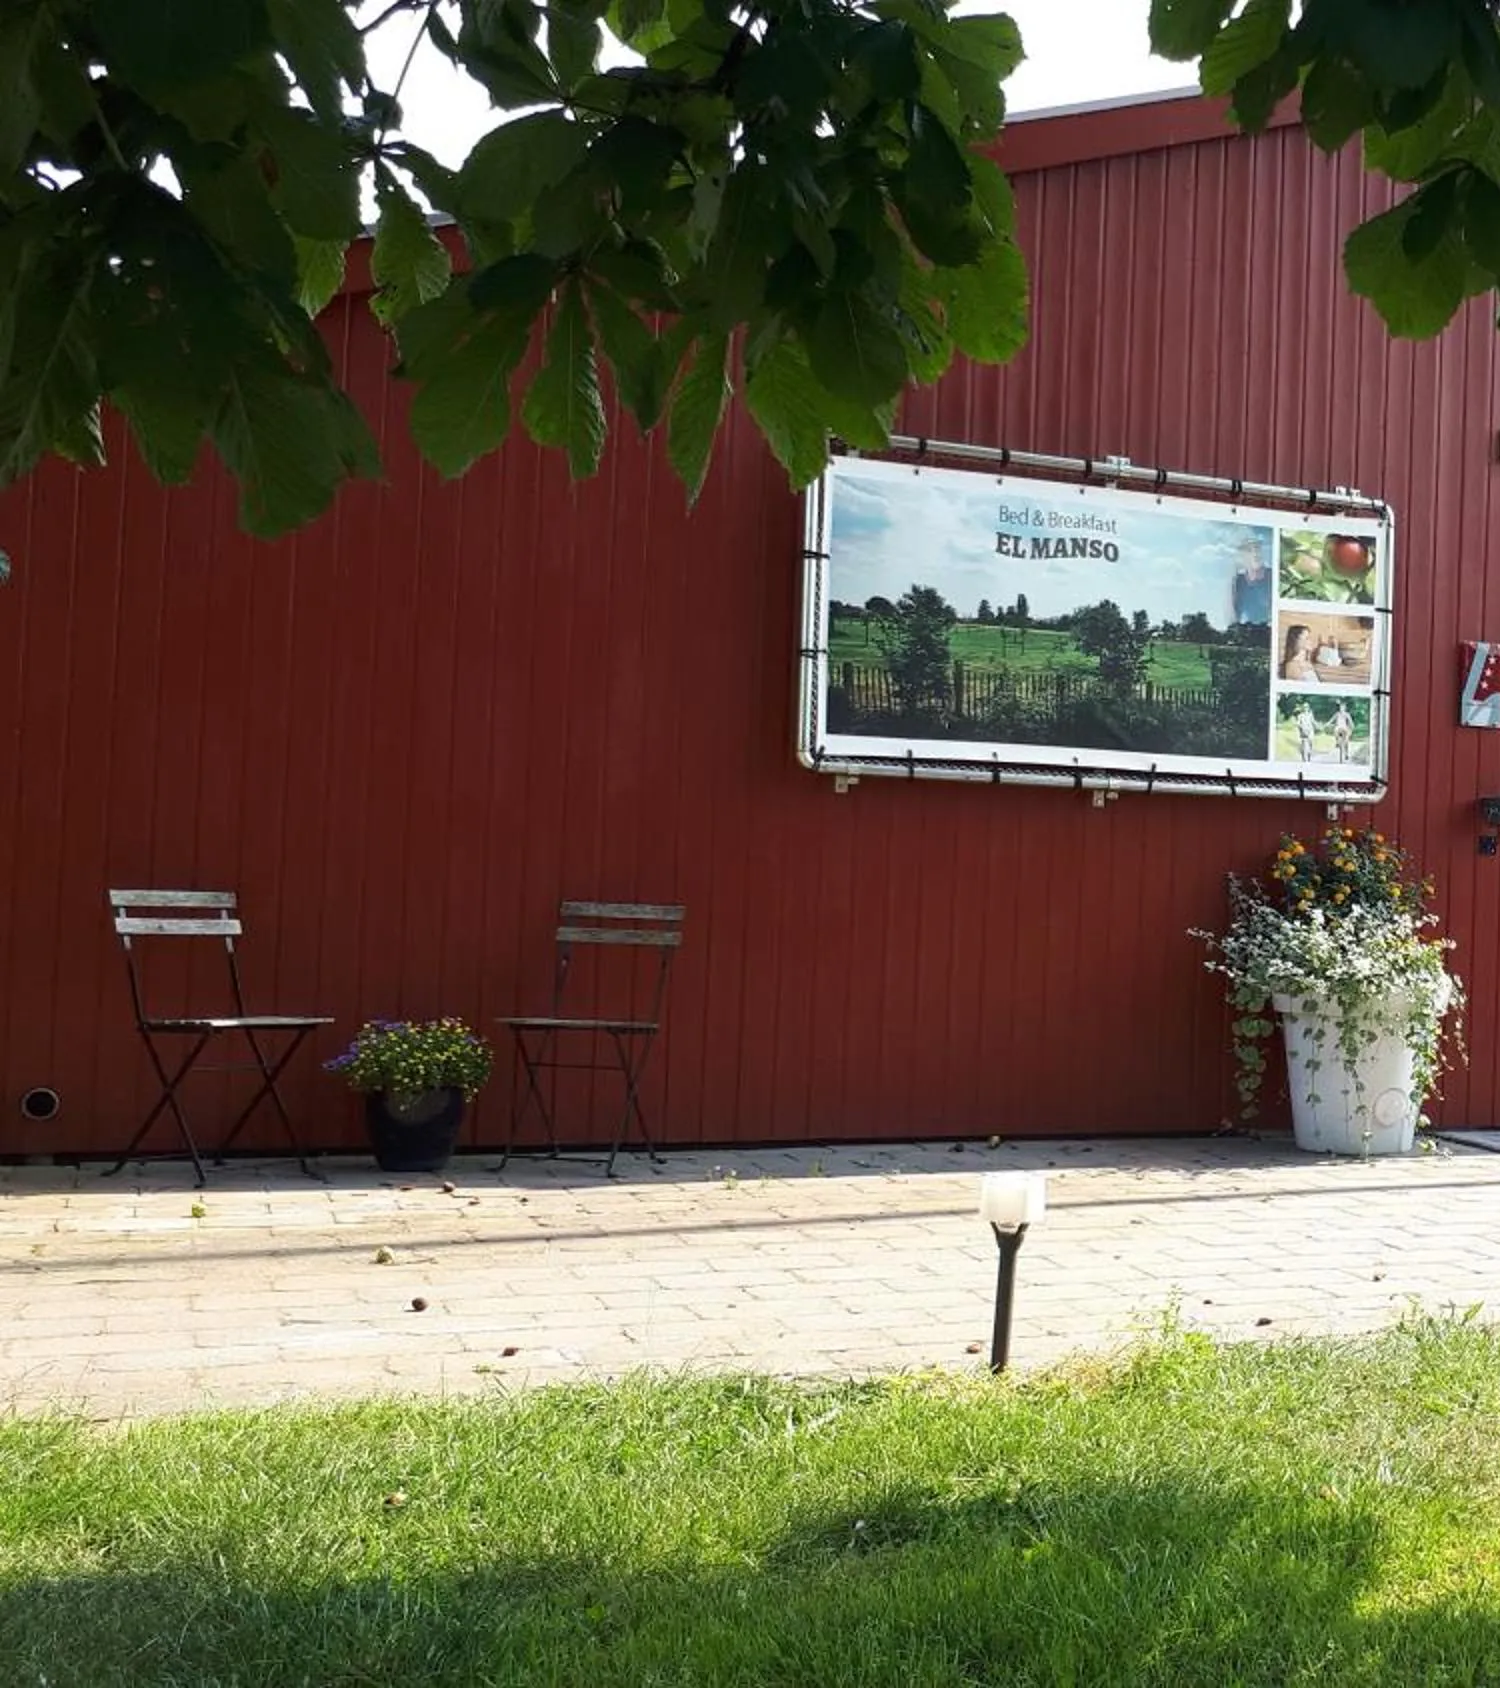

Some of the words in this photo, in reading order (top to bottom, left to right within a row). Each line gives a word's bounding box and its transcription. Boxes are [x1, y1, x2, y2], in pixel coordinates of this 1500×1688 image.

[999, 505, 1029, 526] Bed
[1032, 509, 1045, 527] &
[1048, 511, 1118, 535] Breakfast
[995, 531, 1026, 559] EL
[1029, 537, 1119, 563] MANSO
